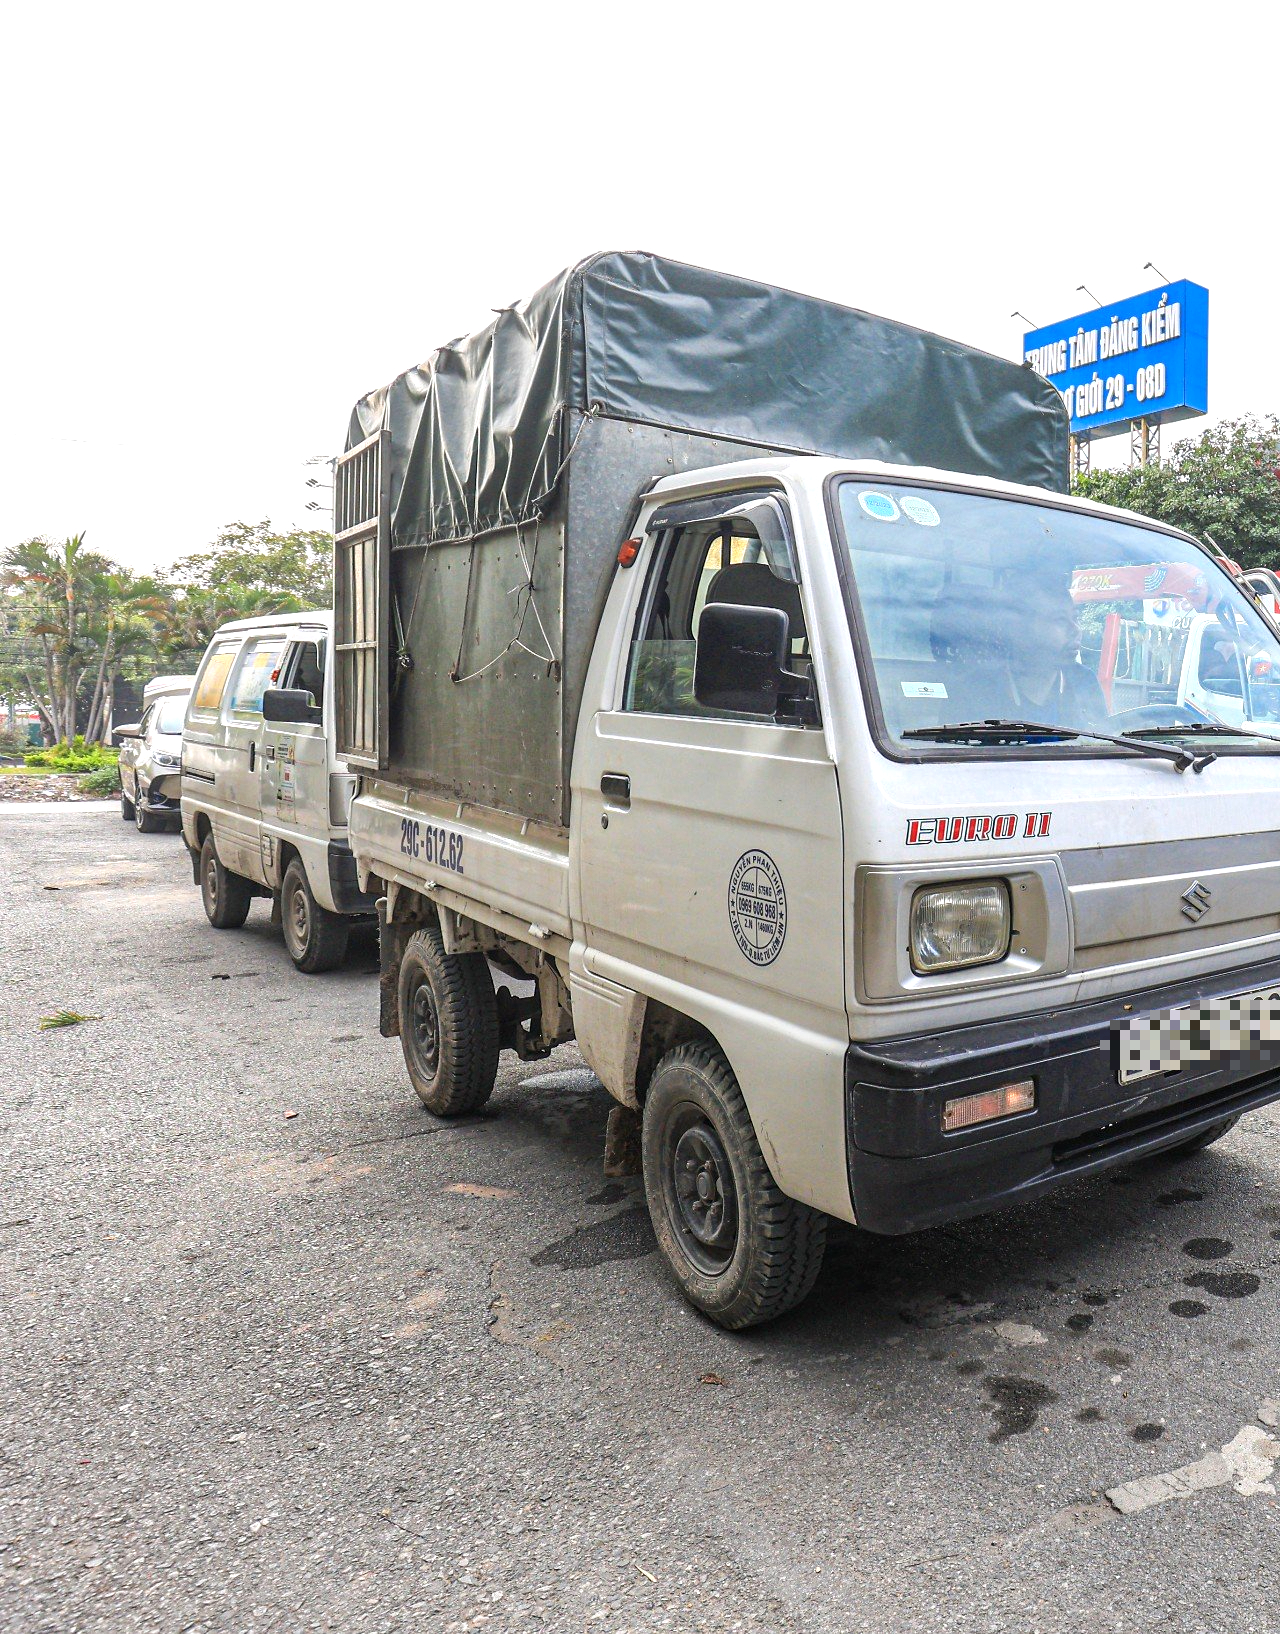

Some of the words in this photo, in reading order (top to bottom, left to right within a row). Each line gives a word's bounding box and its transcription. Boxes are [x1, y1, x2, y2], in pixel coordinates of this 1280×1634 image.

[1025, 339, 1067, 377] TRUNG
[1068, 327, 1098, 369] TÂM
[1099, 315, 1139, 360] ĐĂNG
[1141, 292, 1181, 347] KIỂM
[1076, 372, 1104, 418] GIỚI
[1105, 373, 1125, 410] 29
[1127, 384, 1134, 392] -
[1136, 362, 1166, 402] 08D
[905, 813, 1019, 846] EURO
[1022, 811, 1053, 839] II
